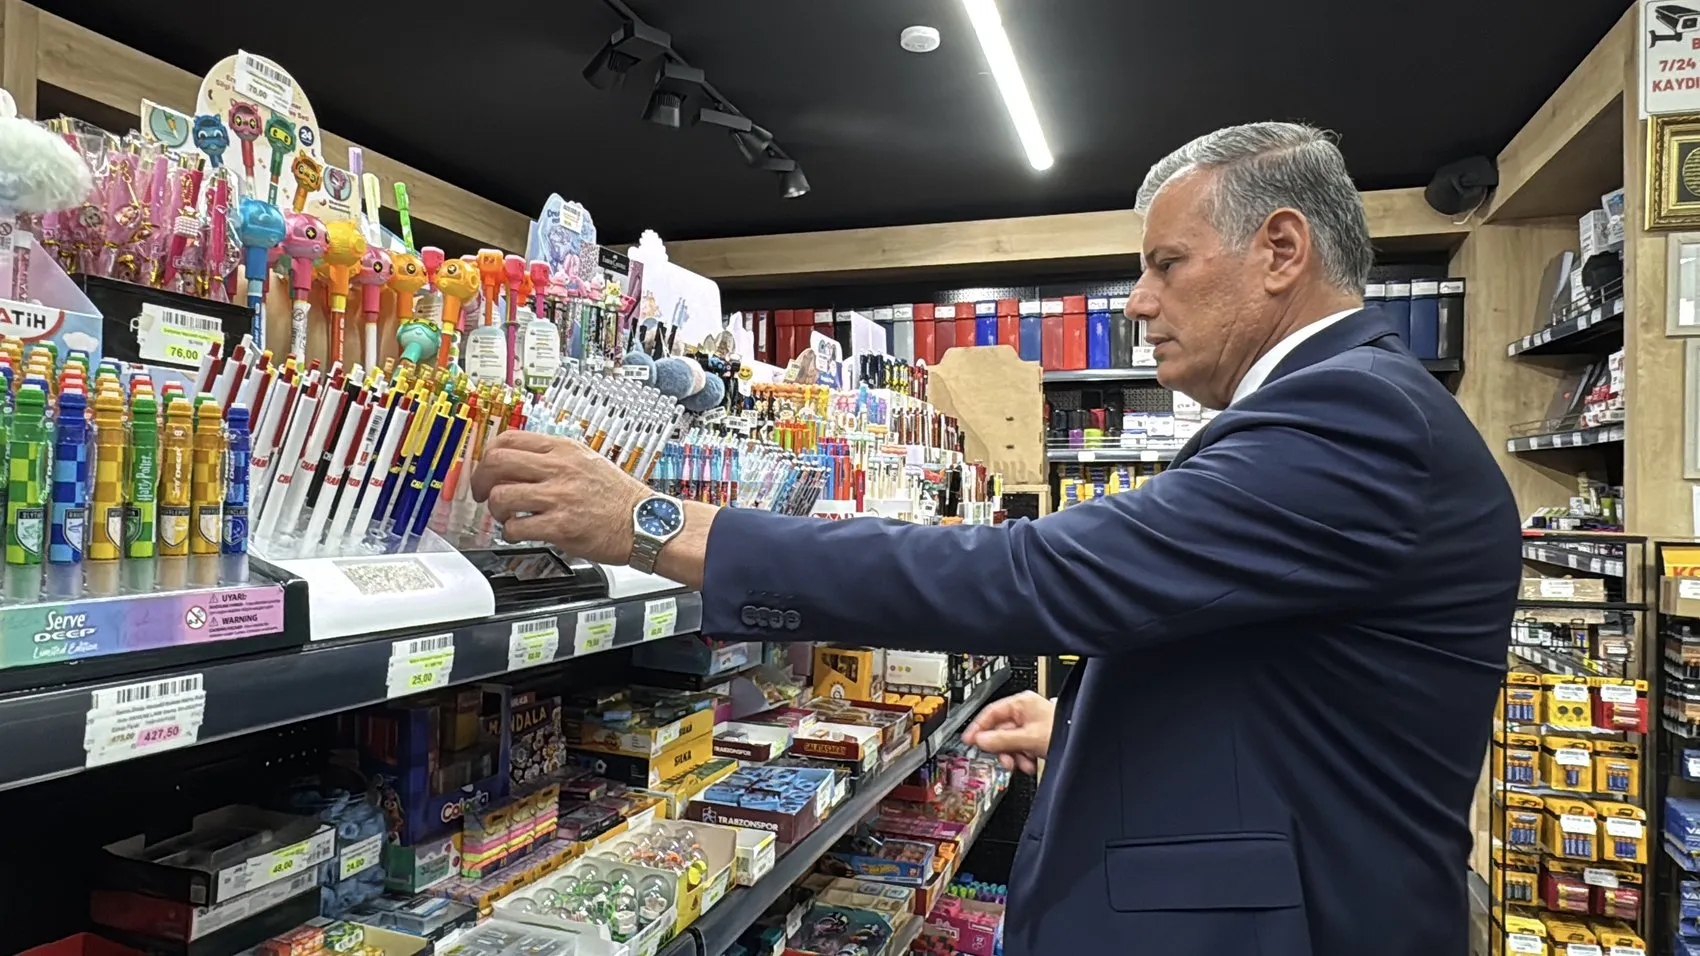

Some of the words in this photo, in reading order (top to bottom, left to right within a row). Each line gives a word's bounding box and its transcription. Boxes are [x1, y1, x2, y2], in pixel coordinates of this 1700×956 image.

[1659, 58, 1697, 72] 7/24
[170, 346, 199, 360] 76,00
[137, 479, 153, 501] Harry
[46, 611, 86, 631] Serve
[222, 614, 258, 625] WARNING
[34, 628, 97, 643] DEEP
[412, 672, 433, 686] 25,00
[144, 726, 180, 742] 427,50
[718, 815, 778, 831] TRABZONSPOR
[272, 860, 294, 874] 48,00
